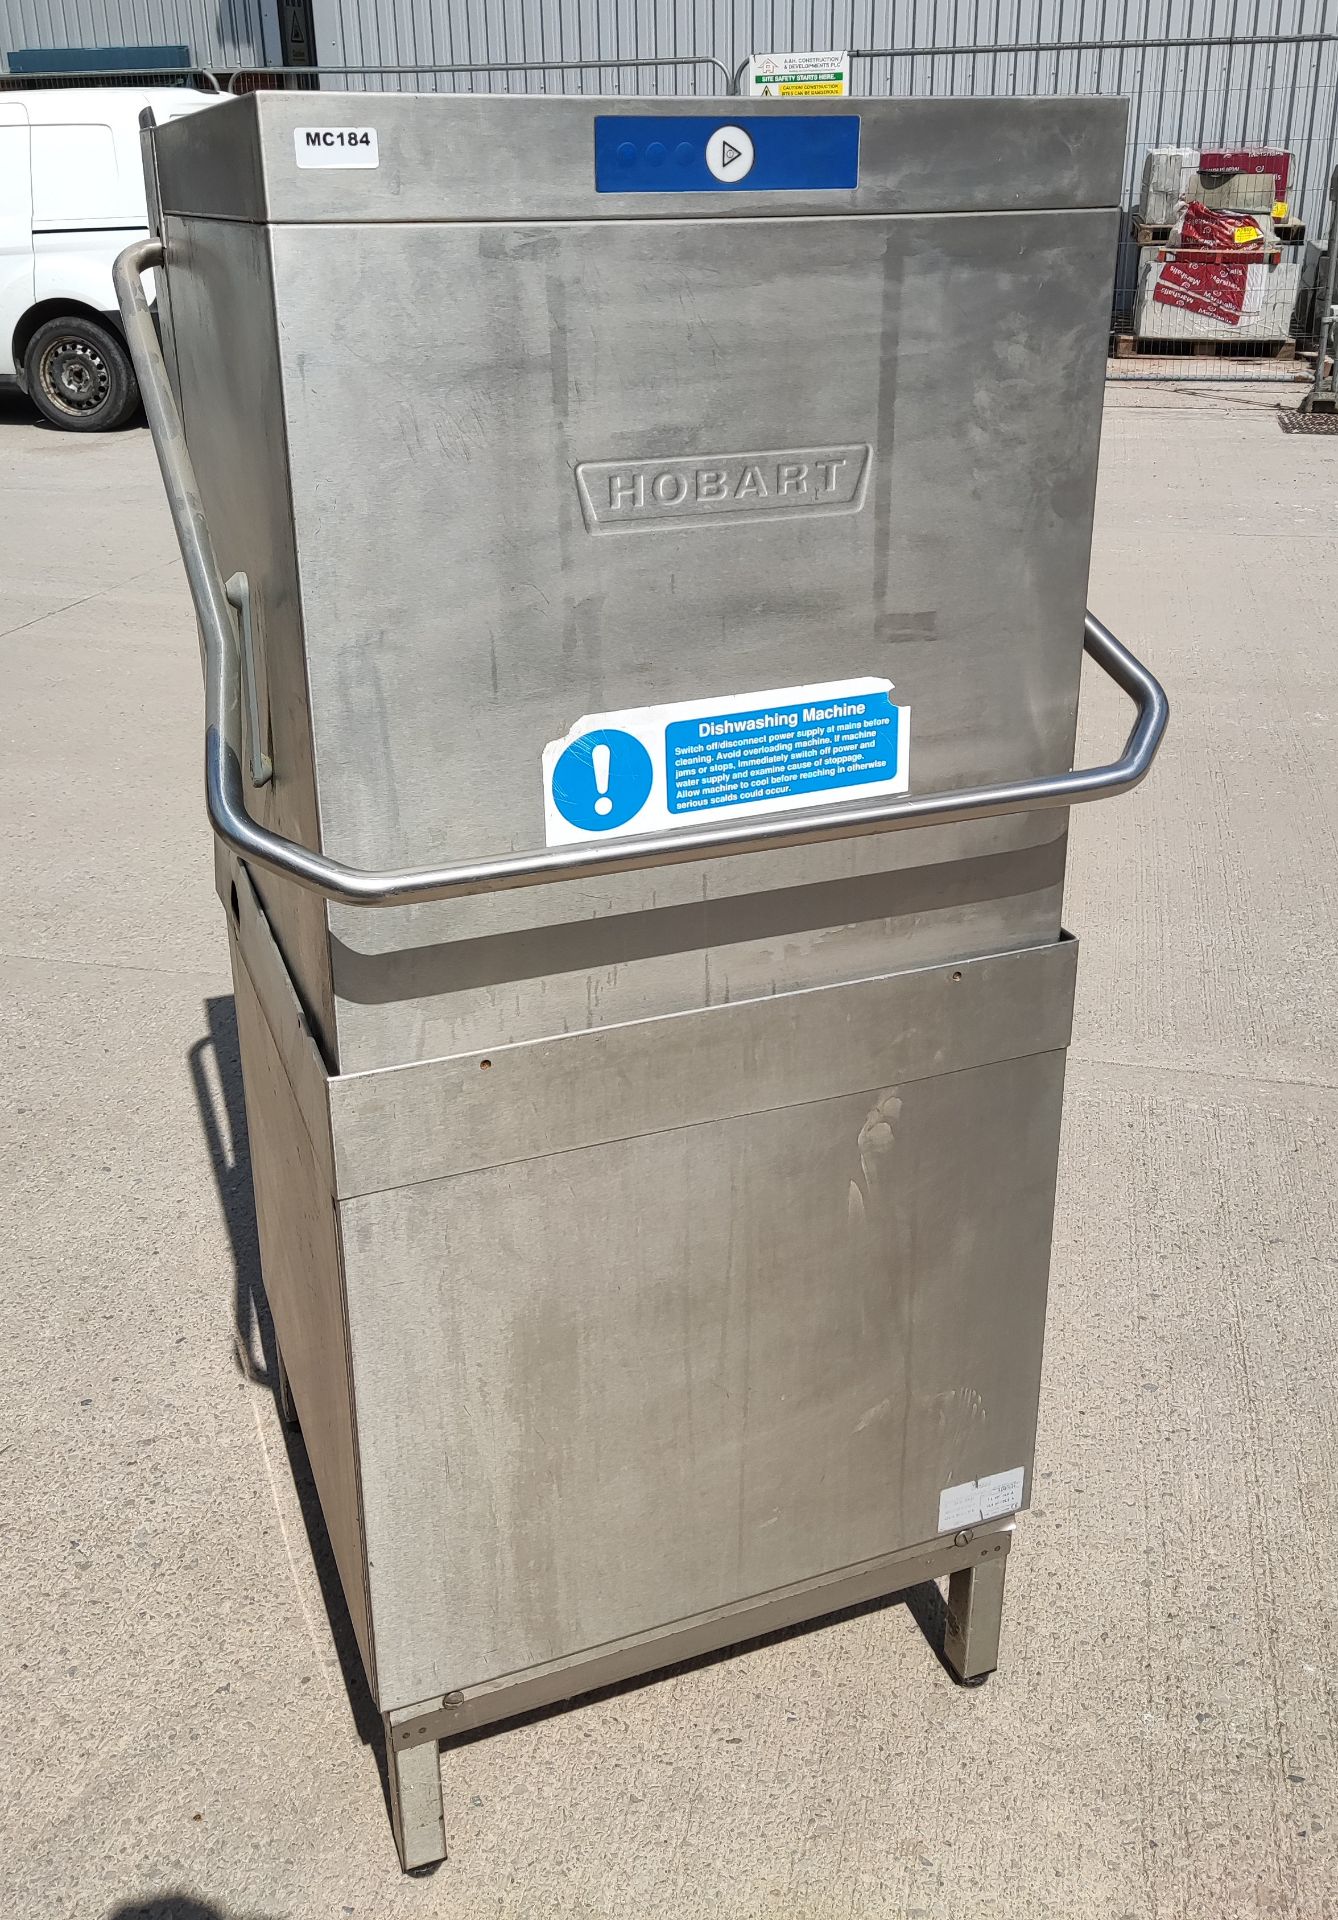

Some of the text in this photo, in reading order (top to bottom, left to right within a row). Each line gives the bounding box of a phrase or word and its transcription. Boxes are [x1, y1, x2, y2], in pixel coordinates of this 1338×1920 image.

[305, 132, 370, 146] MC184
[608, 459, 846, 509] HOBART
[674, 717, 890, 756] Switch off/disconnect power supply at mains before
[698, 703, 866, 738] Dishwashing Machine
[675, 730, 876, 767] cleaning. Avoid overloading machine. If machine
[675, 769, 696, 779] jams
[738, 753, 788, 767] immediately
[790, 749, 817, 760] switch
[820, 746, 831, 756] off
[832, 743, 858, 755] power
[860, 740, 876, 749] and
[675, 753, 864, 788] water supply and examine cause of stoppage.
[676, 759, 886, 799] Allow machine to cool before reaching in otherwise
[676, 785, 791, 810] serious scalds could occur.
